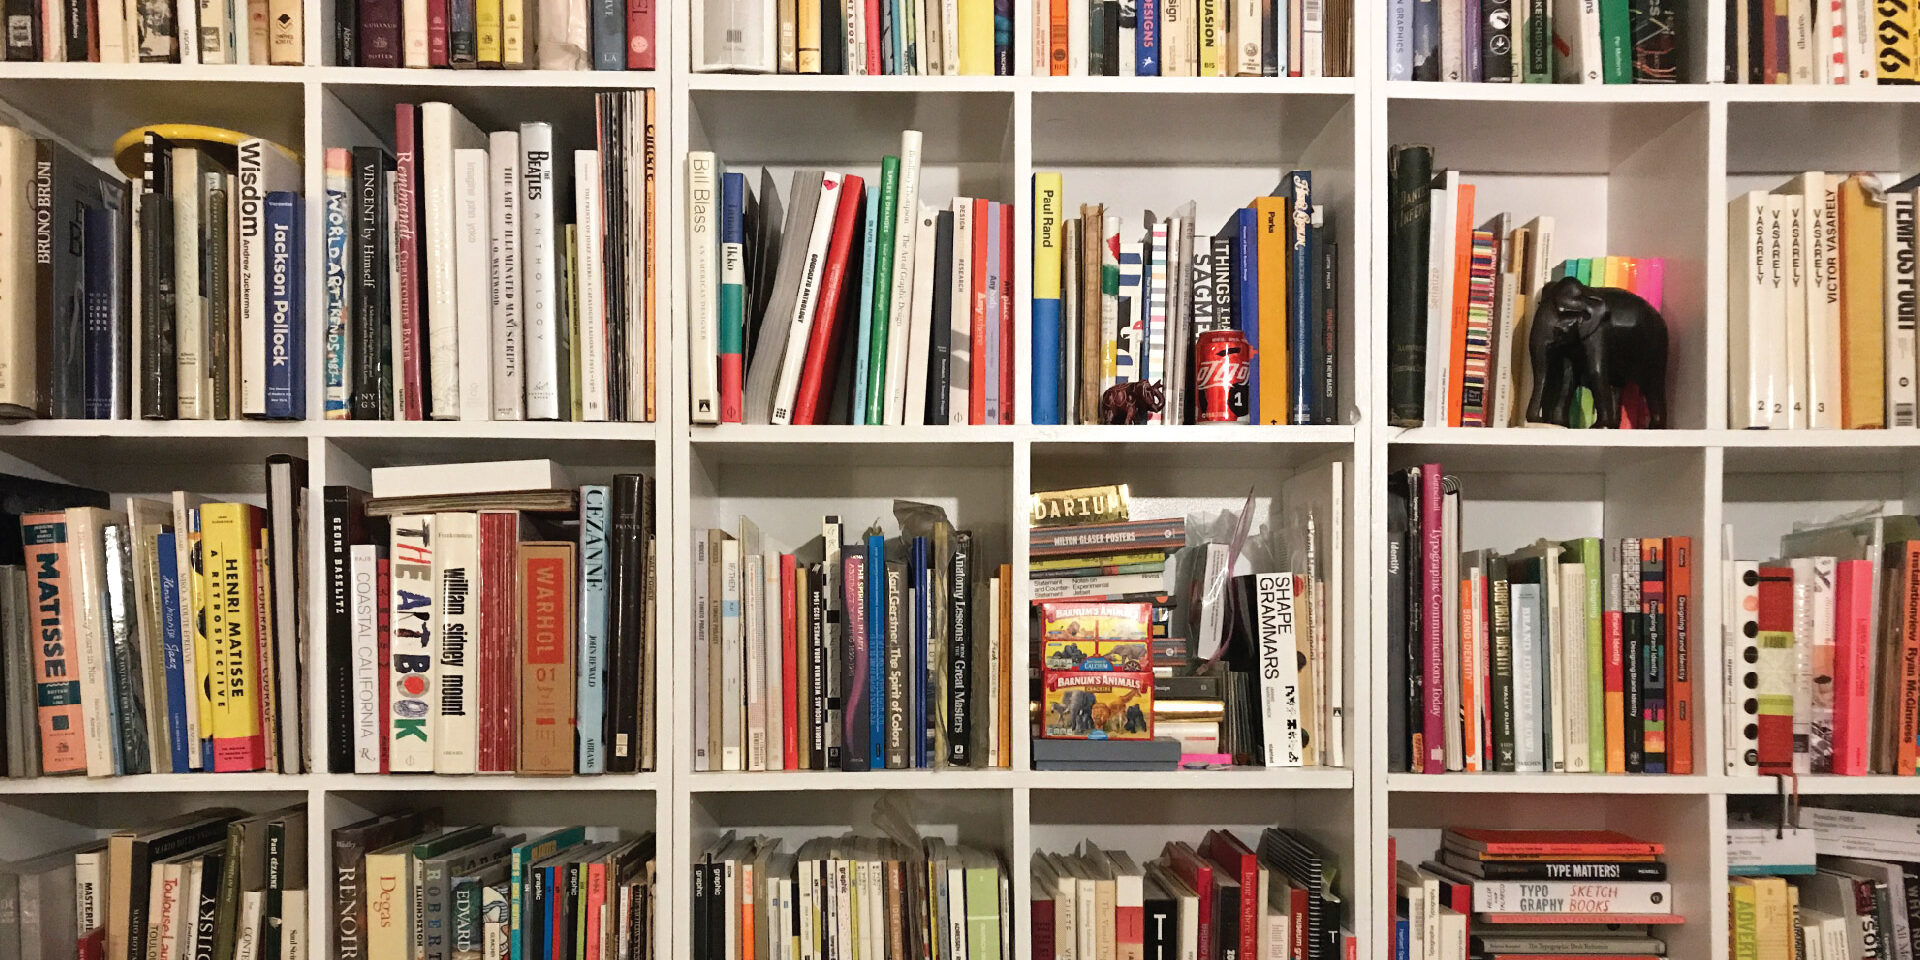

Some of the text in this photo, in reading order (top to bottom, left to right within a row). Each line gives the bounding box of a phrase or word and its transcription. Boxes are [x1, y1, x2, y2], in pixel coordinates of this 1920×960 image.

[343, 28, 351, 60] Abbeville
[241, 142, 261, 237] Wisdom
[363, 164, 375, 224] VINCENT
[524, 151, 549, 200] BEATLES
[693, 159, 710, 233] Bill Blass
[37, 161, 51, 264] BRUNO BRUNI
[328, 194, 345, 259] WORLD
[361, 228, 375, 239] by
[1042, 190, 1054, 248] Paul Rand
[363, 245, 375, 288] Himself
[396, 152, 414, 361] Rembrandt CHRISTOPHER BAKER
[1756, 206, 1764, 284] VASARELY
[1772, 210, 1780, 288] VASARELY
[1792, 209, 1800, 287] VASARELY
[1813, 209, 1822, 288] VASARELY
[1826, 189, 1838, 304] VICTOR VASARELY
[243, 273, 251, 319] Zuckerman
[272, 223, 289, 366] Jackson Pollock
[328, 262, 345, 299] ART
[492, 257, 500, 306] WESTWOOD
[504, 167, 517, 377] THE ART OF ILLUMINATED MANUSCRIPTS
[535, 213, 543, 340] ANTHOLOGY
[327, 300, 343, 351] TRENDS
[797, 287, 812, 323] ANTHOLOGY
[1235, 392, 1242, 406] 1
[1758, 401, 1765, 410] 2
[1774, 403, 1781, 413] 2
[1793, 402, 1801, 410] 4
[1818, 402, 1824, 412] 3
[333, 517, 344, 614] GEORG BASELITZ
[585, 489, 604, 592] CEZANNE
[1389, 542, 1399, 574] Identify
[163, 575, 174, 603] Henri
[728, 562, 736, 592] IF/THEN
[953, 551, 965, 599] Anatomy
[36, 552, 67, 679] MATISSE
[225, 560, 244, 697] HENRI MATISSE
[393, 519, 432, 743] THE ART BOOK
[536, 567, 556, 656] WARHOL
[888, 571, 900, 644] Karl Gerstner
[955, 601, 966, 642] Lessons
[1056, 605, 1139, 618] BARNUM'S ANIMALS
[1259, 577, 1280, 679] GRAMMARS
[1275, 577, 1292, 634] SHAPE
[1429, 527, 1443, 717] Typographic Communications Today
[1493, 580, 1510, 677] CORPORATE IDENTITY
[1612, 613, 1620, 636] Brand
[1649, 601, 1657, 631] Designing
[165, 644, 178, 670] Jazz
[211, 571, 226, 707] RETROSPECTIVE
[356, 572, 375, 738] COASTAL CALIFORNIA
[440, 568, 468, 716] william sidney mount
[588, 635, 597, 687] JOHN REWALD
[1463, 609, 1473, 681] BRAND IDENTITY
[1611, 638, 1620, 666] Identity
[1629, 641, 1637, 672] Designing
[1650, 652, 1658, 676] Identity
[1677, 597, 1686, 680] Designing Brand Identity
[1904, 551, 1920, 743] Installationview Ryan McGinness
[537, 668, 556, 682] 01
[888, 648, 902, 748] The Spirit of Colors
[955, 660, 965, 689] Great
[1057, 674, 1140, 687] BARNUM'S ANIMALS
[1521, 607, 1535, 753] BRAND IDENTITY NOW!
[955, 692, 965, 733] Masters
[586, 737, 595, 768] ABRAMS
[270, 857, 279, 889] CÉZANNE
[570, 869, 578, 896] graphic
[696, 870, 704, 897] graphic
[713, 869, 722, 895] graphic
[839, 867, 848, 894] graphic
[1520, 885, 1618, 897] TYPO SKETCH
[1546, 863, 1620, 878] TYPE MATTERS!
[339, 867, 359, 960] RENOIR
[373, 876, 397, 928] Degas
[416, 885, 424, 947] HOLZSCHNITTE
[456, 890, 471, 951] EDVARD
[1520, 899, 1610, 912] GRAPHY BOOKS
[1201, 923, 1209, 953] BRUNO
